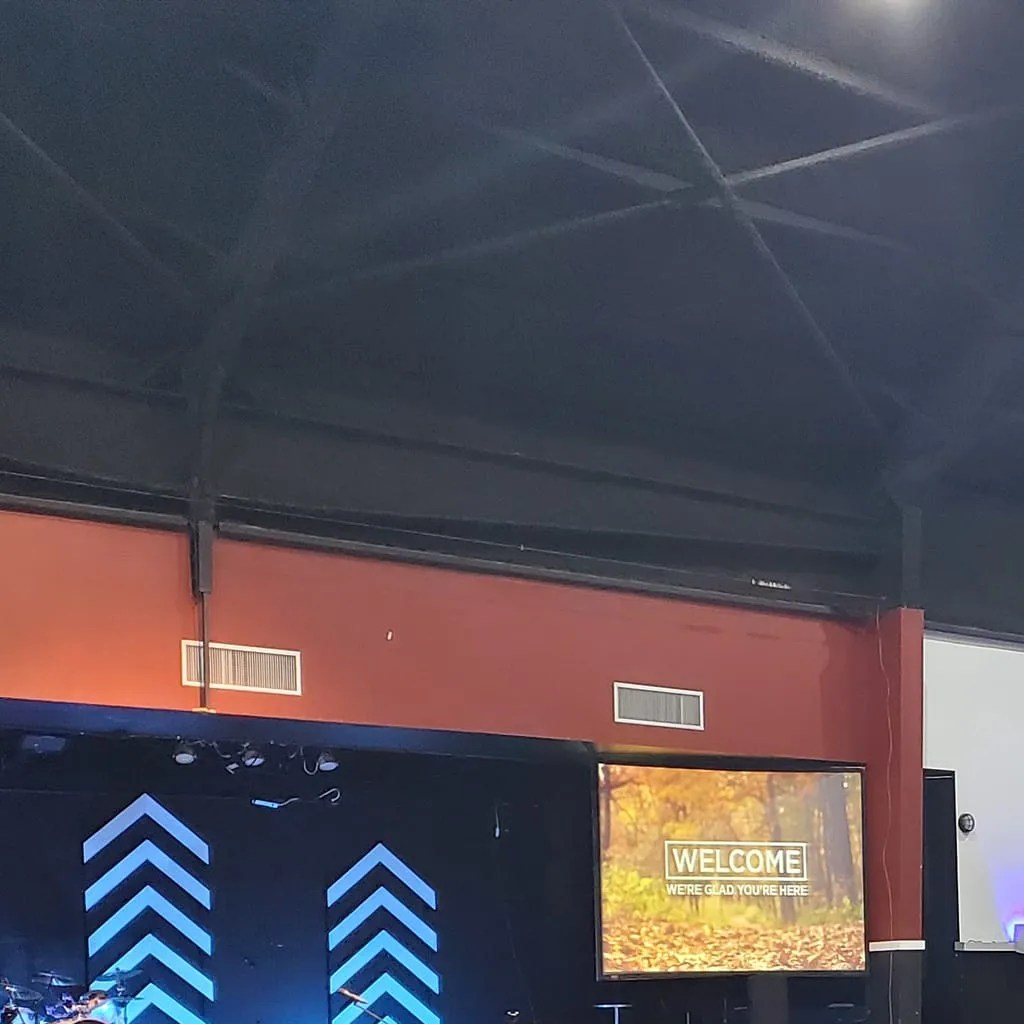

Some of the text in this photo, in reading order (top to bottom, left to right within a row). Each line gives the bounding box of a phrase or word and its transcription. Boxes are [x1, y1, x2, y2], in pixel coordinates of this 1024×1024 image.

[672, 848, 801, 873] WELCOME
[666, 883, 809, 896] WE'RE GLAD YOU'RE HERE
